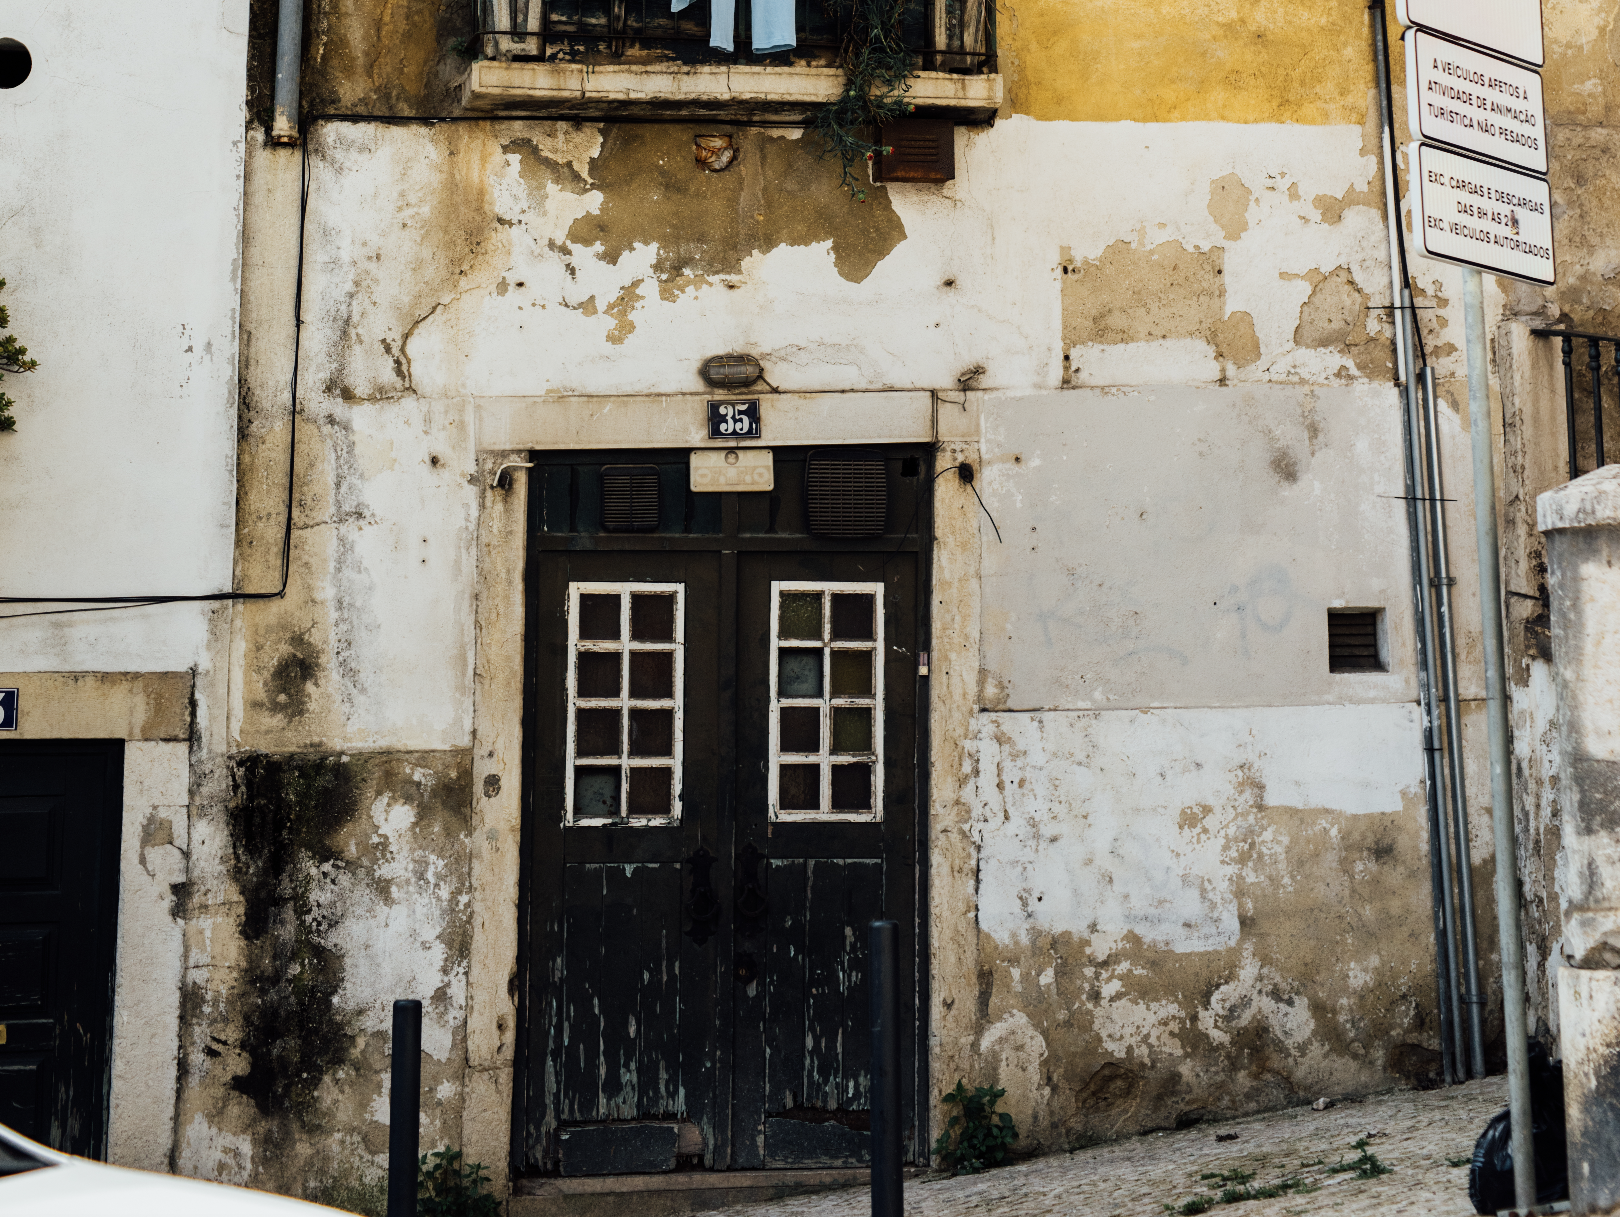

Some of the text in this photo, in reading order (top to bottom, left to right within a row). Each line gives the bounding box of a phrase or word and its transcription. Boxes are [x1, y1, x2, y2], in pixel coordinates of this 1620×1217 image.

[1433, 57, 1439, 72] A
[1441, 59, 1485, 87] VEÍCULOS
[1488, 76, 1520, 99] AFETOS
[1427, 79, 1536, 127] ATIVIDADE DE ANIMAÇÃO
[1427, 103, 1538, 151] TURÍSTICA NÃO PESADOS
[1428, 170, 1544, 215] EXC. CARGAS E DESCARGAS
[1457, 201, 1502, 225] DAS 8H ÀS
[1427, 215, 1447, 232] EXC.
[1448, 221, 1491, 244] VEÍCULOS
[1493, 233, 1550, 260] AUTORIZADOS
